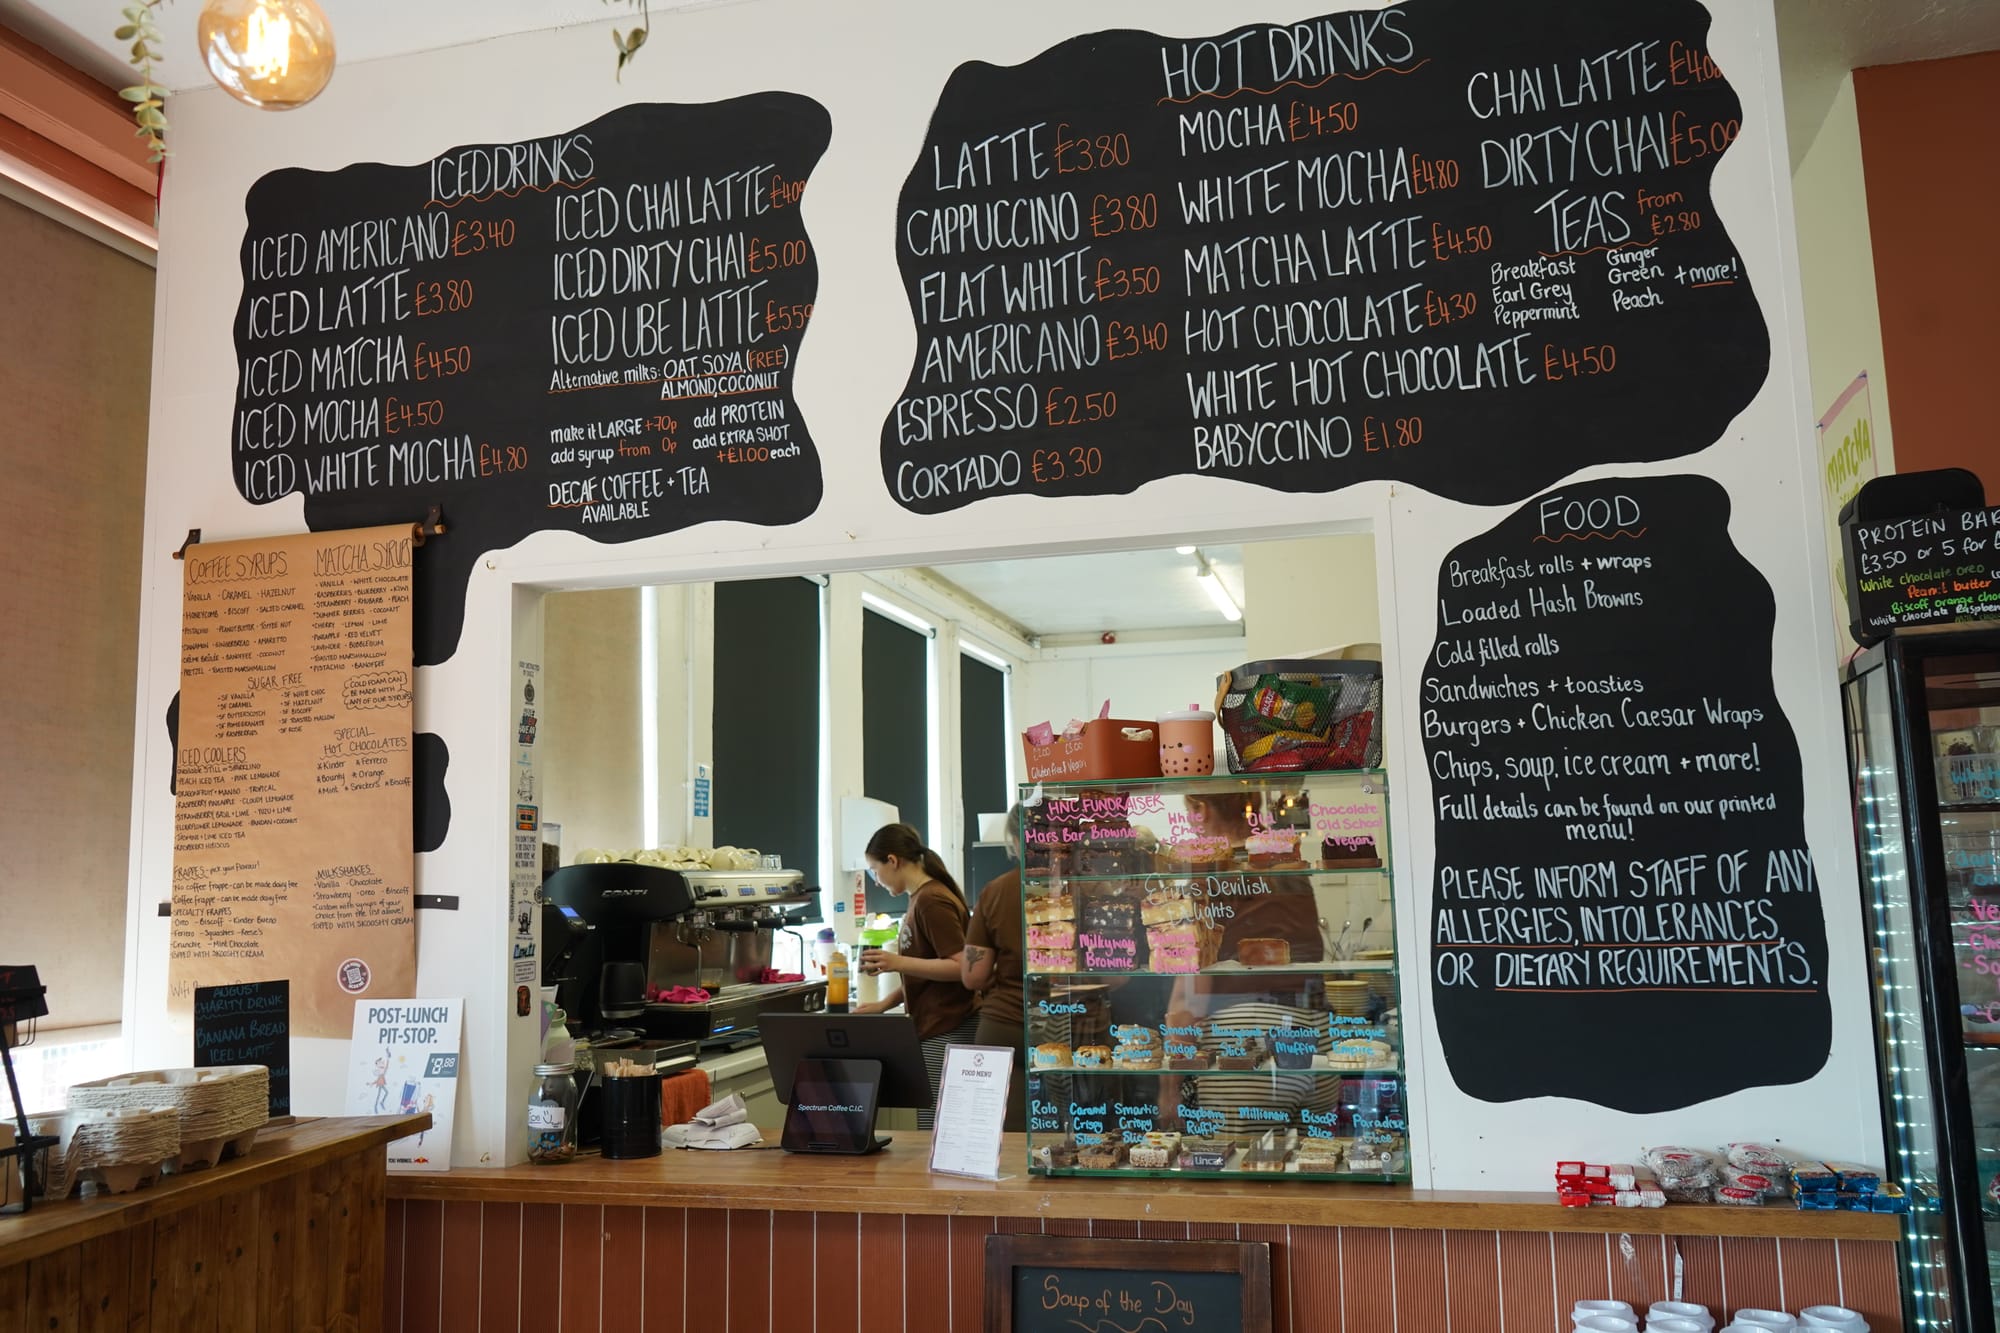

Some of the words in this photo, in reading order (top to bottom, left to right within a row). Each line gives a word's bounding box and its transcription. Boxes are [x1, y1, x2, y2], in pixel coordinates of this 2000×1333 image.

[1161, 30, 1257, 99] HOT
[1268, 9, 1414, 82] DRINKS
[1467, 67, 1546, 119] CHAI
[1553, 39, 1666, 108] LATTE
[1179, 103, 1286, 157] MOCHA
[1288, 102, 1358, 142] £4.50
[428, 146, 497, 202] ICED
[493, 134, 594, 192] DRINKS
[933, 122, 1050, 191] LATTE
[1054, 123, 1131, 174] £3.80
[555, 186, 620, 242] ICED
[626, 179, 680, 233] CHAI
[686, 163, 775, 225] LATTE
[906, 191, 1080, 257] CAPPUCCINO
[1090, 193, 1157, 237] £3.80
[1533, 189, 1631, 253] TEAS
[1637, 189, 1684, 216] from
[1651, 212, 1700, 235] £2.80
[252, 232, 307, 281] ICED
[315, 211, 449, 274] AMERICANO
[451, 219, 515, 257] £3.40
[554, 247, 607, 301] ICED
[612, 239, 683, 295] DIRTY
[688, 231, 746, 285] CHAI
[748, 237, 807, 273] £5.00
[1490, 255, 1576, 285] Breakfast
[1606, 246, 1661, 270] Ginger
[1608, 264, 1665, 285] Green
[920, 263, 995, 325] FLAT
[1001, 245, 1096, 314] WHITE
[1095, 259, 1161, 302] £3.50
[248, 290, 310, 340] ICED
[318, 268, 411, 332] LATTE
[415, 279, 473, 316] £3.80
[1493, 303, 1581, 329] Peppermint
[1612, 286, 1664, 312] Peach
[921, 307, 1100, 384] AMERICANO
[1106, 321, 1168, 361] £3.40
[549, 368, 620, 391] Alternative
[621, 363, 662, 386] milks:
[1186, 362, 1278, 420] WHITE
[1290, 350, 1353, 406] HOT
[1362, 332, 1537, 399] CHOCOLATE
[1544, 345, 1616, 381] £4.50
[693, 407, 717, 429] add
[721, 399, 785, 426] PROTEIN
[896, 383, 1038, 446] ESPRESSO
[1045, 386, 1117, 426] £2.50
[692, 433, 718, 450] add
[719, 428, 755, 447] EXTRA
[755, 423, 791, 442] SHOT
[1193, 415, 1352, 470] BABYCCINO
[1363, 417, 1422, 452] £1.80
[1828, 418, 1871, 494] MATCHA
[549, 476, 598, 506] DECAF
[601, 468, 664, 502] COFFEE
[675, 466, 710, 496] TEA
[897, 450, 1021, 502] CORTADO
[1031, 447, 1102, 483] £3.30
[581, 500, 651, 524] AVAILABLE
[1540, 495, 1640, 535] FOOD
[1858, 519, 1945, 550] PROTEIN
[190, 555, 231, 584] COFFEE
[236, 551, 288, 577] SYRUPS
[316, 544, 368, 572] MATCHA
[1862, 550, 1906, 574] £3.50
[1918, 547, 1932, 559] or
[1942, 539, 1955, 556] 5
[1963, 537, 1987, 555] for
[1449, 556, 1535, 589] Breakfast
[1538, 554, 1574, 575] rolls
[1596, 556, 1652, 574] wraps
[1860, 576, 1894, 592] White
[1900, 568, 1951, 584] chocolate
[1954, 580, 1992, 591] butter
[187, 593, 211, 601] VANILLA
[222, 589, 251, 600] CARAMEL
[261, 588, 295, 598] HAZELNUT
[1440, 599, 1521, 626] Loaded
[1528, 583, 1577, 617] Hash
[1583, 579, 1643, 609] Browns
[1891, 599, 1929, 614] Biscoff
[1935, 596, 1974, 609] orange
[248, 676, 278, 689] SUGAR
[282, 673, 302, 685] FREE
[1425, 673, 1540, 704] Sandwiches
[1564, 675, 1644, 694] toasties
[335, 727, 375, 740] SPECIAL
[1423, 709, 1512, 747] Burgers
[1531, 702, 1615, 731] Chicken
[1621, 696, 1696, 728] Caesar
[1702, 697, 1764, 730] Wraps
[180, 748, 200, 765] ICED
[204, 747, 246, 763] COOLERS
[324, 744, 342, 754] HOT
[350, 737, 407, 751] CHOCOLATES
[359, 770, 384, 781] Orange
[1048, 802, 1079, 816] HNC
[1083, 794, 1165, 813] FUNDRAISER
[1248, 813, 1276, 827] Old
[1316, 819, 1339, 830] Old
[1343, 817, 1383, 830] School
[1025, 829, 1059, 844] Mars
[1062, 828, 1085, 842] Bar
[317, 865, 371, 878] MILKSHAKES
[1440, 865, 1525, 901] PLEASE
[1534, 860, 1618, 899] INFORM
[1629, 854, 1707, 898] STAFF
[1717, 849, 1749, 894] OF
[1765, 849, 1814, 893] ANY
[1206, 876, 1271, 897] Devilish
[1086, 952, 1134, 968] Brownie
[1495, 950, 1590, 988] DIETARY
[1598, 942, 1818, 986] REQUIREMENTS.
[247, 995, 283, 1009] DRINK
[368, 1007, 448, 1024] POST-LUNCH
[1039, 1000, 1086, 1014] Scones
[1159, 1024, 1203, 1036] Smartie
[1329, 1012, 1368, 1025] Lemon
[197, 1024, 246, 1048] BANANA
[250, 1020, 285, 1038] BREAD
[379, 1027, 437, 1044] PIT-STOP.
[1269, 1027, 1320, 1039] Chocolate
[1275, 1041, 1317, 1055] Muffin
[961, 1069, 975, 1077] FOOD
[1031, 1100, 1057, 1115] Rolo
[1115, 1104, 1159, 1115] Smartie
[1031, 1118, 1059, 1130] Slice
[1073, 1118, 1103, 1133] Crispy
[1119, 1118, 1152, 1132] Crispy
[1308, 1126, 1334, 1139] Slice
[1042, 1275, 1090, 1317] Soup
[1096, 1289, 1111, 1316] of
[1120, 1291, 1142, 1312] the
[1152, 1281, 1194, 1325] Day
